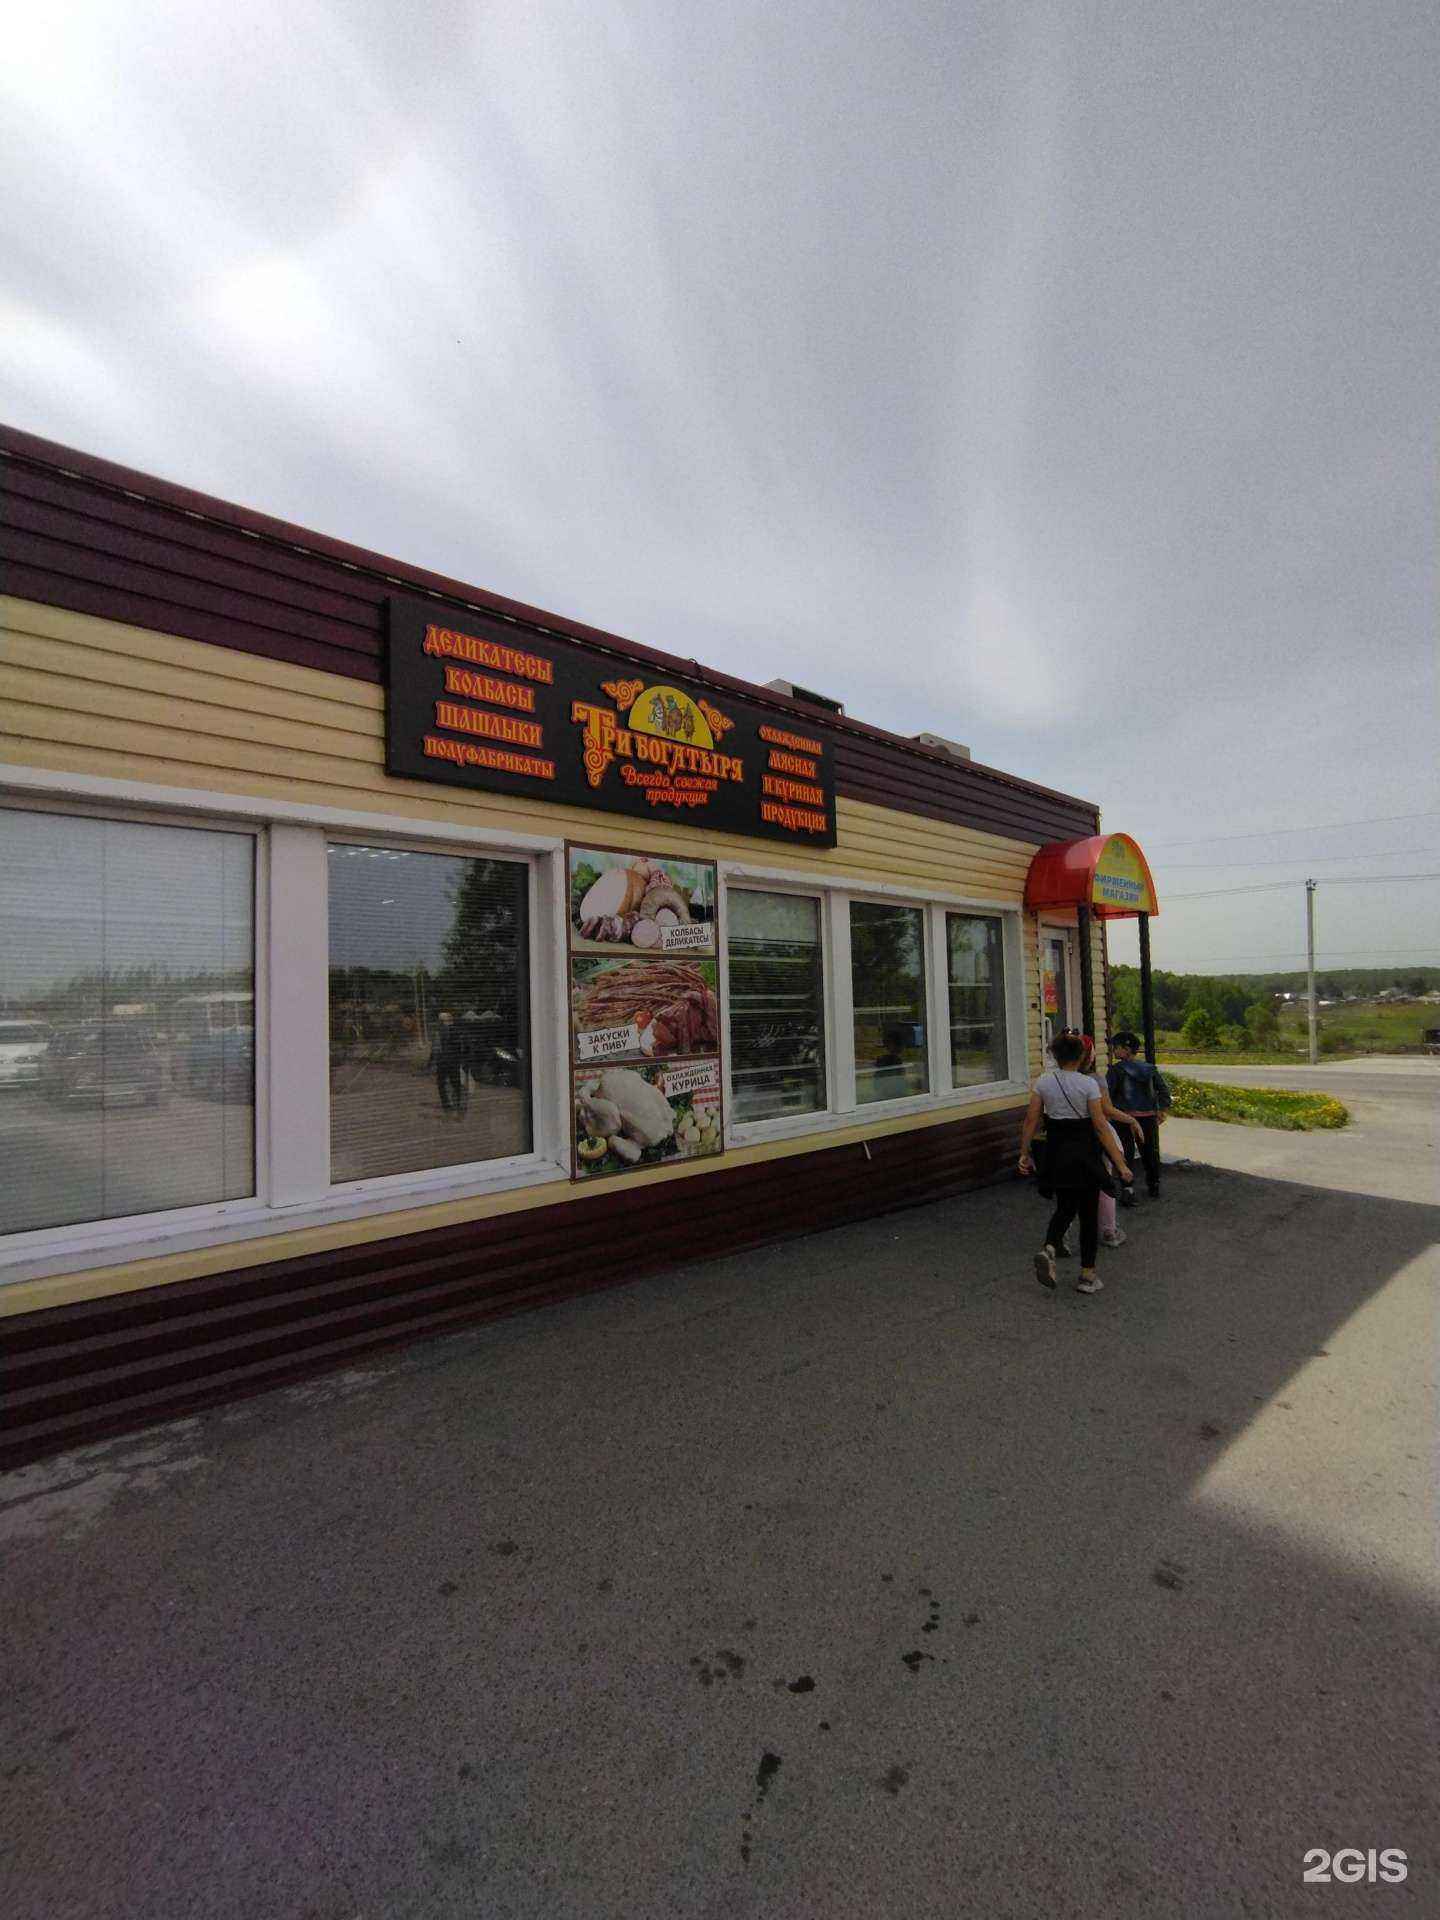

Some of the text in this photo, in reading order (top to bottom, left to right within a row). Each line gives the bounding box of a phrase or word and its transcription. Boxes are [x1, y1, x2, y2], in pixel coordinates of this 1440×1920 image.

[423, 624, 554, 685] ДЕЛИКАТЕСЫ
[444, 665, 535, 713] КОЛБАСЫ
[435, 700, 543, 749] ШАШЛЫКИ
[423, 735, 555, 781] ПОЛУФАБРИКАТЫ
[635, 736, 743, 783] БОГАТЫРЯ
[768, 751, 817, 780] МЯСНАЯ
[620, 764, 718, 792] Всегда свежая
[761, 774, 773, 797] И
[645, 787, 708, 808] продукция
[760, 801, 827, 833] ПРОДУКЦИЯ
[1103, 887, 1140, 902] МАГАЗИН
[665, 935, 709, 948] ДЕЛИКАТЕСЫ
[669, 926, 704, 938] КОЛБАСЫ
[588, 1029, 630, 1045] ЗАКУСКИ
[592, 1039, 628, 1054] К ПИВУ
[671, 1076, 711, 1092] КУРИЦА
